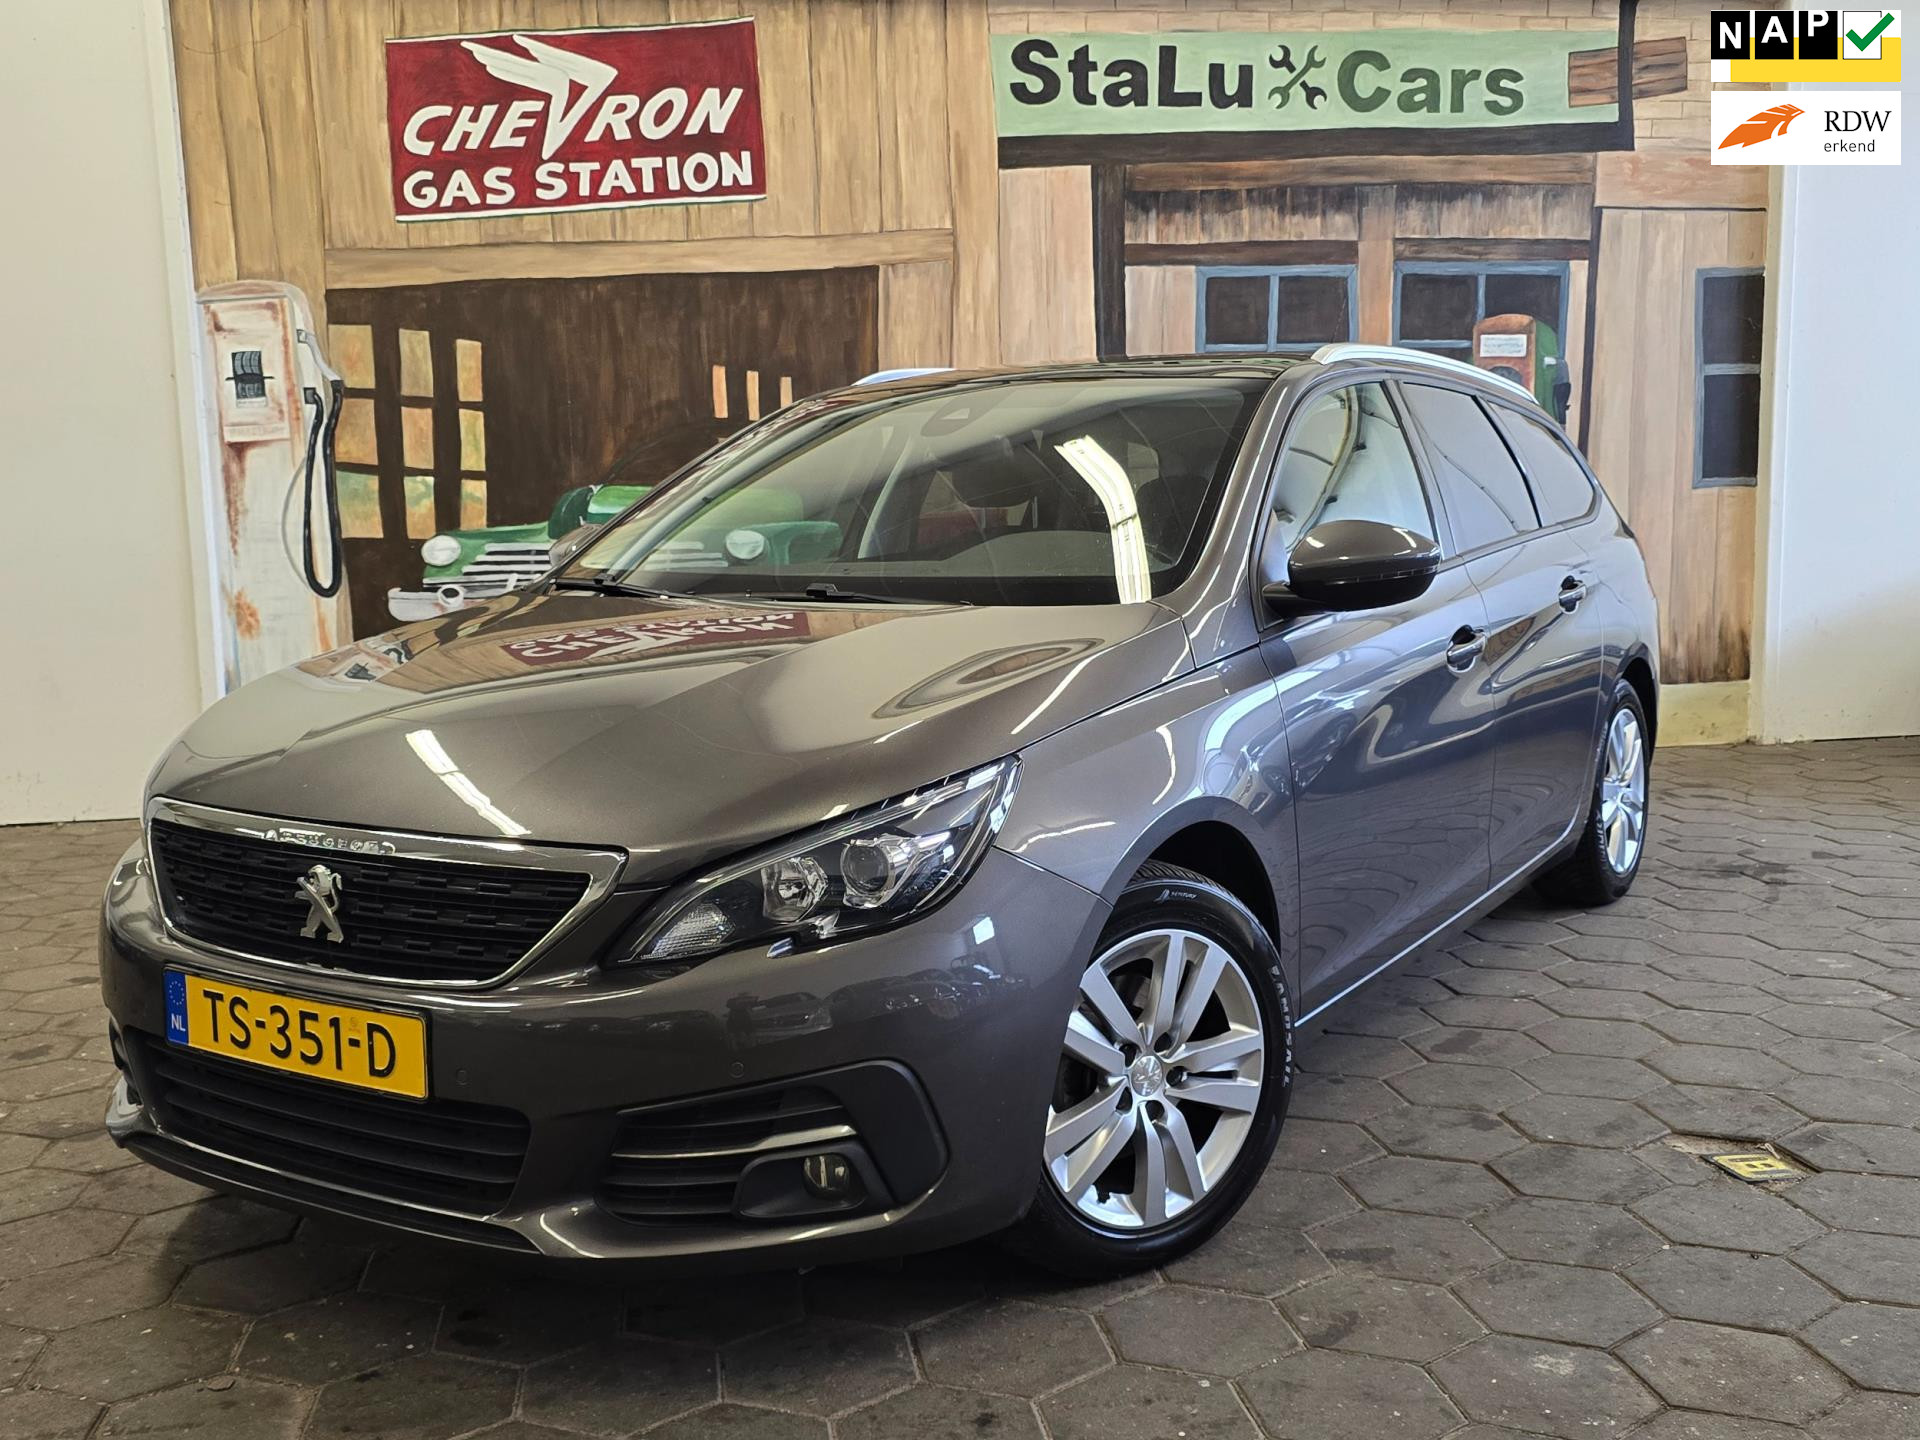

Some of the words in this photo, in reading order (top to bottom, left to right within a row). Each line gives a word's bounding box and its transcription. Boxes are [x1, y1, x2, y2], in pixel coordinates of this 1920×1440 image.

[403, 34, 743, 160] CHEVRON
[1009, 39, 1254, 109] StaLu
[1337, 49, 1524, 116] Cars
[403, 166, 516, 209] GAS
[535, 150, 754, 200] STATION
[171, 1014, 186, 1031] NL
[203, 988, 396, 1078] TS-351-D
